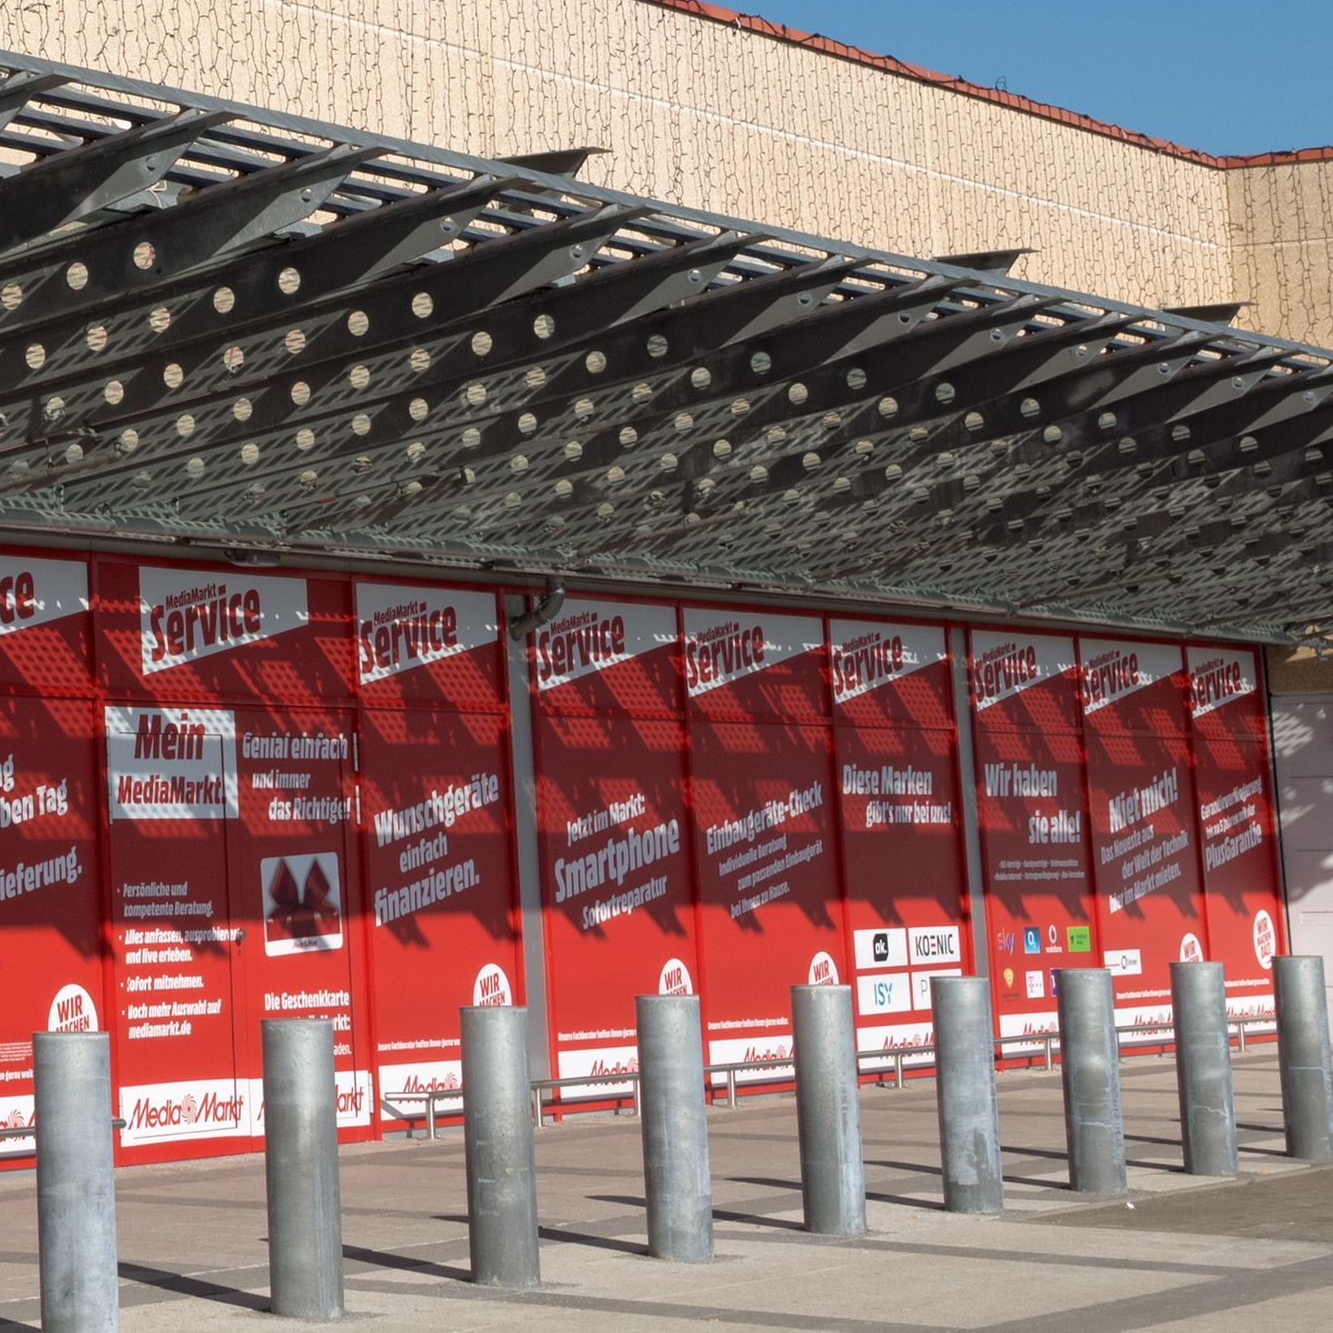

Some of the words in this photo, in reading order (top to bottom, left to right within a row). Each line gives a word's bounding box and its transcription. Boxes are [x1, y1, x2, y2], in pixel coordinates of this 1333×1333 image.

[165, 583, 217, 611] MediaMarkt
[373, 600, 420, 627] MediaMarkt
[150, 584, 262, 662] Service
[359, 602, 458, 675] Service
[538, 612, 625, 682] Service
[686, 621, 765, 689] Service
[833, 632, 904, 696] Service
[973, 642, 1037, 704] Service
[1082, 650, 1139, 708] Service
[1190, 658, 1242, 710] Service
[134, 713, 206, 760] Mein
[242, 732, 289, 760] Genial
[290, 732, 348, 760] einfach
[36, 778, 69, 816] Tag
[117, 774, 227, 805] MediaMarkt.
[274, 769, 311, 789] immer
[843, 763, 879, 795] Diese
[881, 765, 933, 795] Marken
[985, 762, 1012, 797] Wir
[1012, 762, 1058, 798] haben
[267, 797, 292, 821] das
[292, 796, 351, 825] Richtige!
[374, 772, 499, 847] Wunschgeräte
[706, 780, 823, 855] Einbaugeräte-Check
[913, 800, 930, 823] bei
[930, 801, 951, 824] uns!
[1108, 786, 1141, 834] Miet
[1141, 766, 1179, 818] mich!
[566, 813, 593, 848] Jetzt
[609, 792, 646, 826] Markt:
[1028, 809, 1049, 844] sie
[1050, 809, 1081, 844] alle!
[399, 831, 448, 874] einfach
[554, 818, 680, 903] Smartphone
[1205, 820, 1263, 872] PlusGarantie
[123, 882, 171, 898] Persönliche
[174, 900, 214, 918] Beratung.
[374, 858, 480, 927] finanzieren.
[582, 875, 668, 930] Sofortreparatur
[997, 927, 1015, 955] sky
[153, 974, 204, 990] mitnehmen.
[281, 989, 350, 1010] Geschenkkarte
[479, 972, 500, 998] WIR
[873, 982, 893, 1006] ISY
[56, 994, 83, 1023] WIR
[128, 1096, 183, 1131] Media
[193, 1091, 244, 1124] Markt
